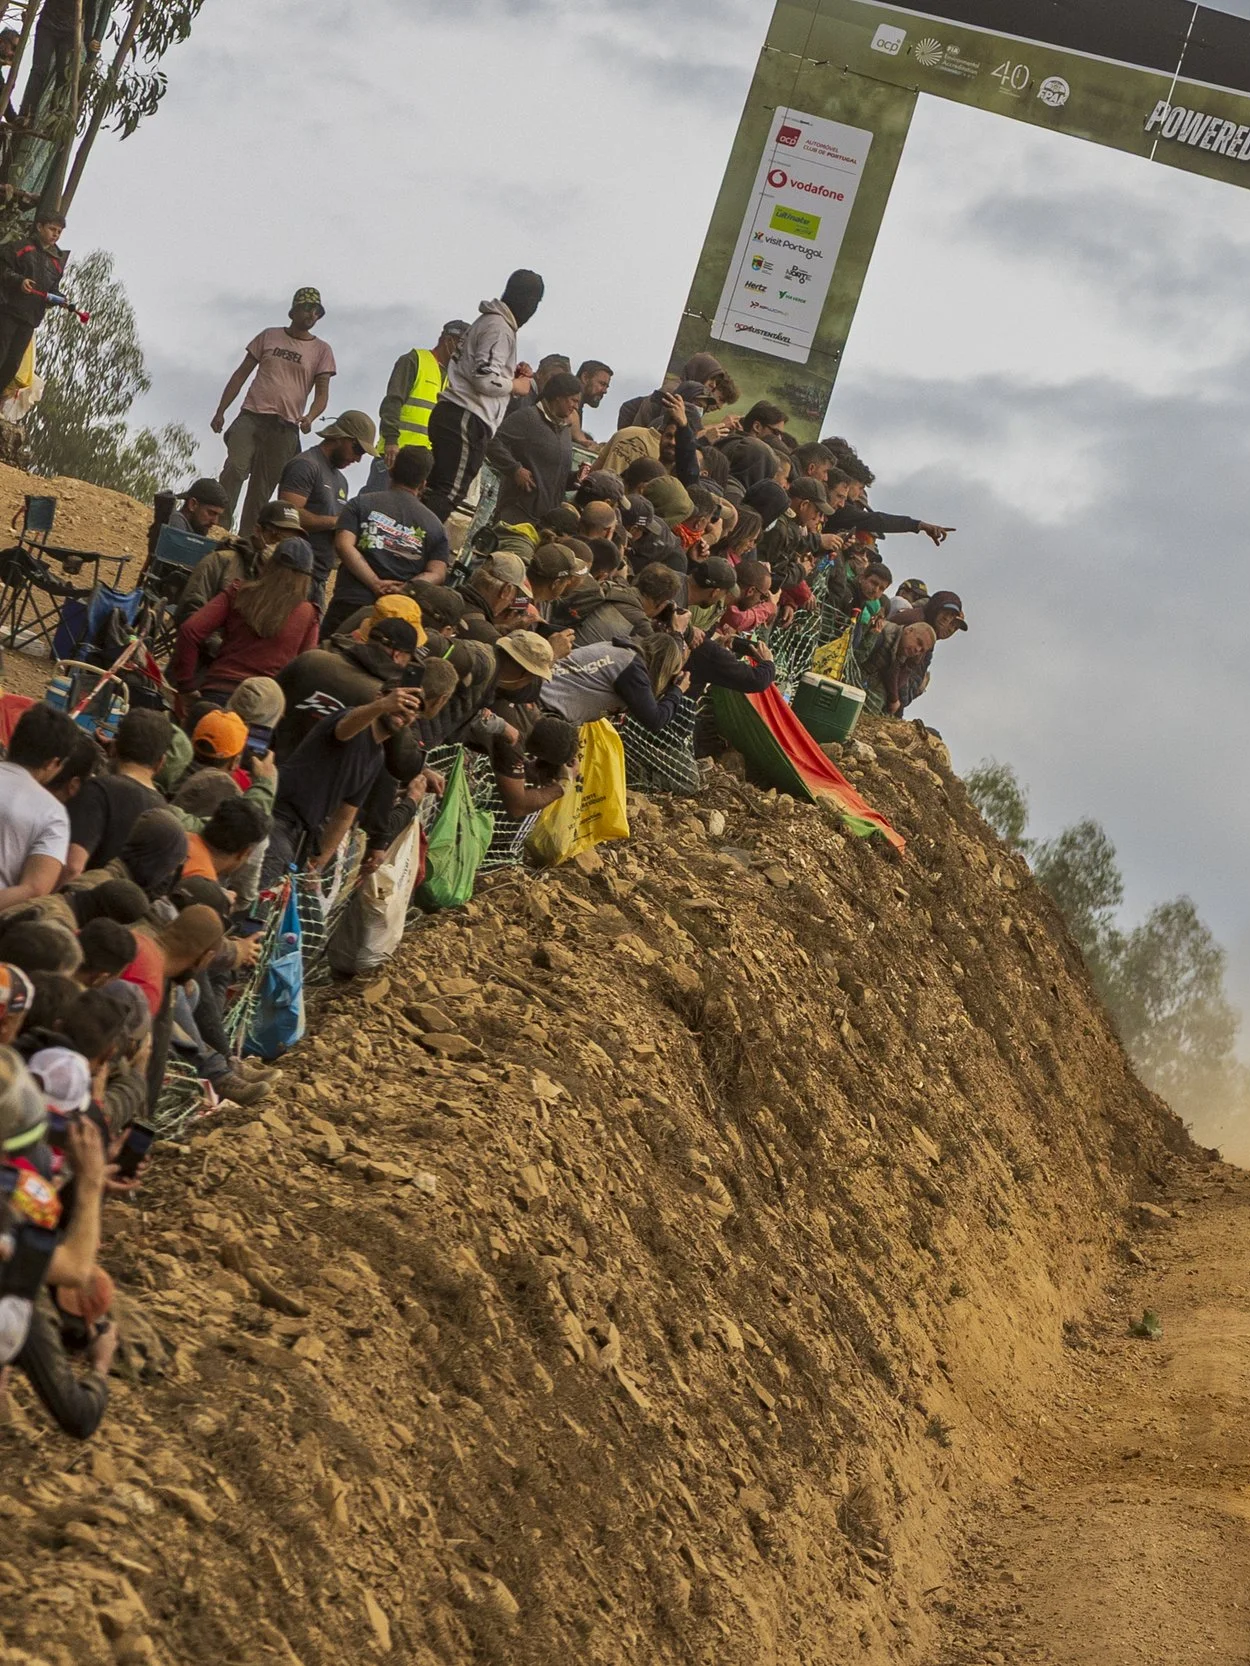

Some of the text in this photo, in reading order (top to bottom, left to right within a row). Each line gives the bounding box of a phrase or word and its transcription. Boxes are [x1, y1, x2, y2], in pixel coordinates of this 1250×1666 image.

[790, 179, 845, 202] vodafone
[765, 236, 824, 260] visit Portugal
[744, 280, 768, 293] Hertz
